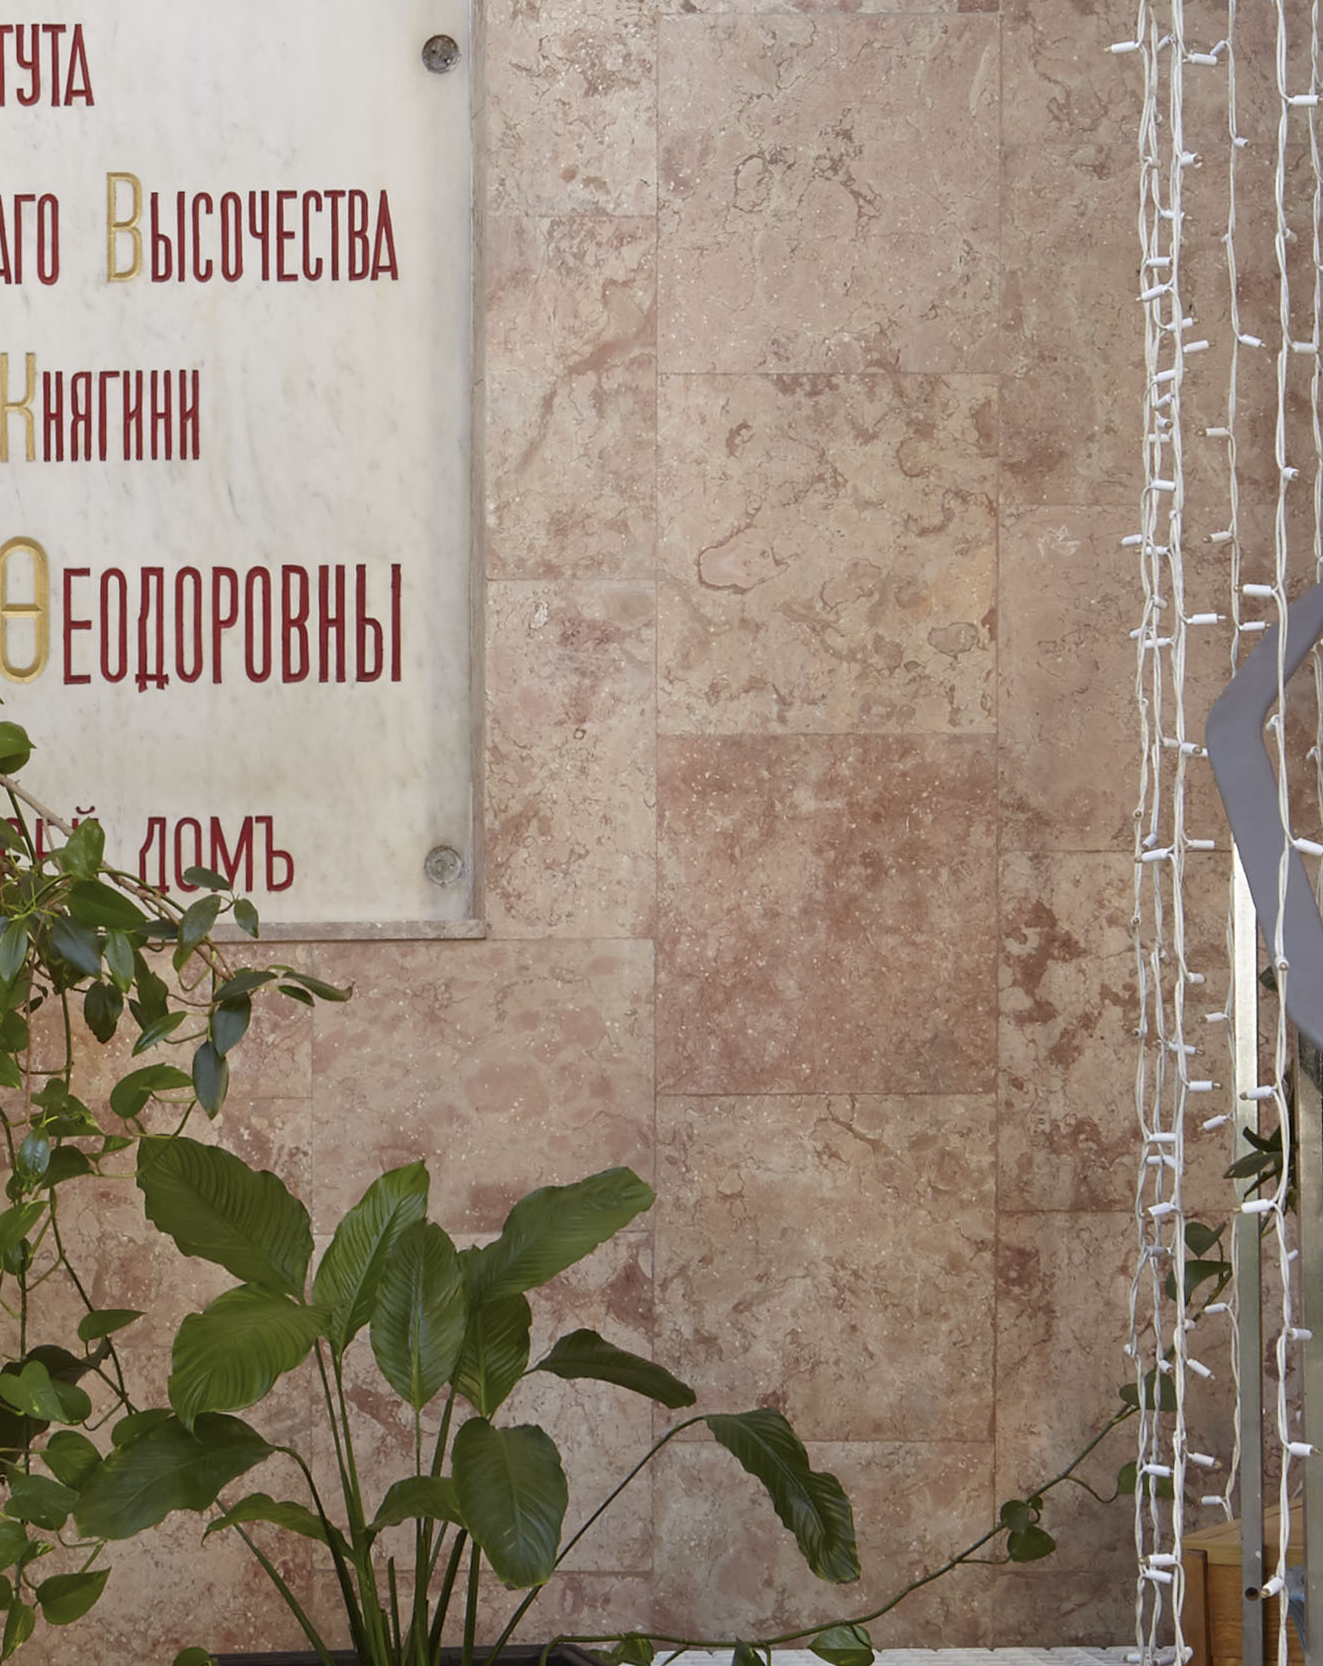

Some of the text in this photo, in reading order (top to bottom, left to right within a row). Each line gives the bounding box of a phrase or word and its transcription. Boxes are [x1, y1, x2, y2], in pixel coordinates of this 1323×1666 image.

[106, 172, 399, 283] ВЫСОЧЕСТВА
[0, 352, 201, 462] КНЯГИНИ
[137, 815, 294, 893] ДОМЪ
